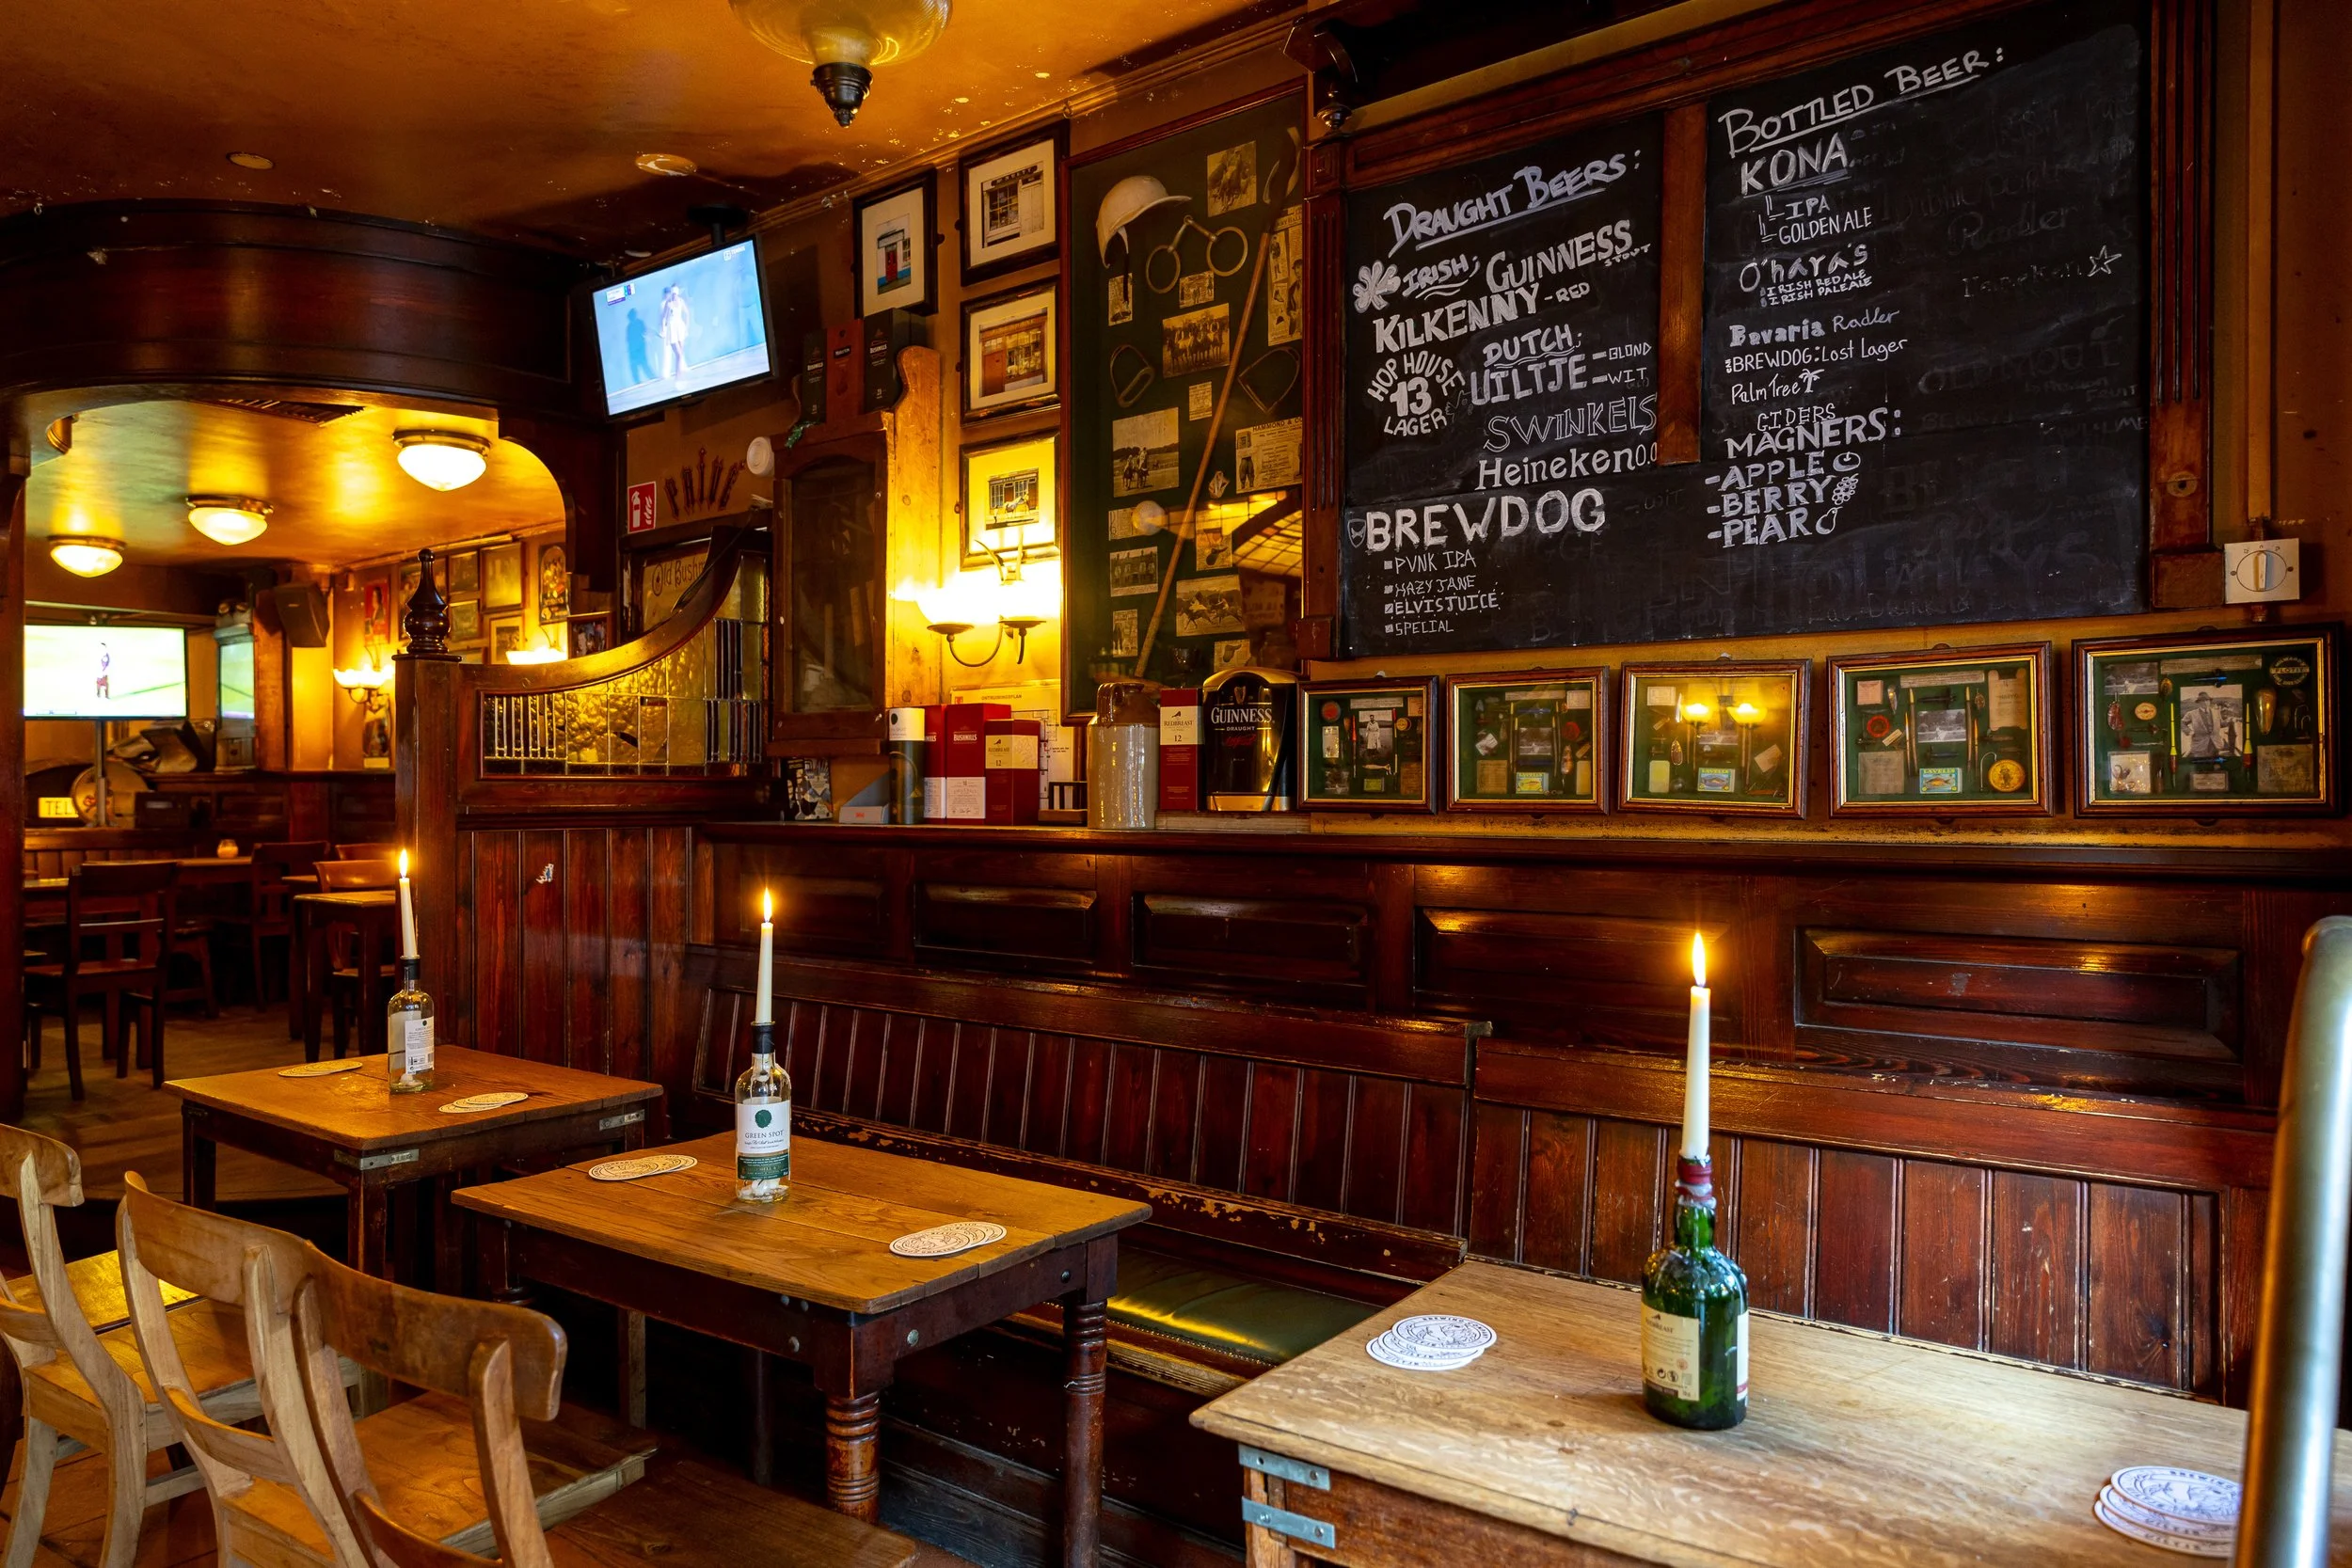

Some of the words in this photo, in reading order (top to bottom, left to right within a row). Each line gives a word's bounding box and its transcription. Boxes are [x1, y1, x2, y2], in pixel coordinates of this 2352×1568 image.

[1718, 85, 1874, 159] BOTTLED
[1740, 133, 1849, 197] KONA
[1383, 184, 1513, 258] DRAUGHT
[1778, 214, 1840, 245] GOLDEN
[1843, 206, 1872, 231] ALE
[1785, 194, 1831, 220] IPA
[1486, 219, 1633, 293] GUINNESS
[1603, 243, 1651, 267] STOUT
[1767, 279, 1812, 297] IRISH
[1816, 275, 1841, 288] RED
[1842, 269, 1867, 281] ALE
[1768, 290, 1813, 306] IRISH
[1818, 283, 1848, 296] PALE
[1848, 276, 1872, 291] ALE
[1373, 283, 1539, 354] KILKENNY
[1729, 318, 1826, 348] Bavaria
[1833, 307, 1900, 332] Radler
[1822, 339, 1854, 362] Lost
[1861, 337, 1908, 362] Lager
[1367, 357, 1399, 402] HOP
[1403, 350, 1466, 396] HOUSE
[1470, 353, 1588, 405] UILTJE
[1731, 382, 1767, 405] Palm
[1769, 373, 1801, 399] Tree
[1390, 376, 1432, 417] 13
[1383, 407, 1448, 437] LAGER
[1483, 392, 1658, 452] SWINKELS
[1474, 448, 1636, 490] Heineken
[1365, 488, 1607, 552] BREWDOG
[651, 560, 672, 596] Old
[1395, 579, 1434, 597] HAZY
[1436, 575, 1477, 594] JANE
[1395, 597, 1444, 615] ELVIS
[1444, 592, 1499, 612] JUICE
[1395, 620, 1454, 636] SPECIAL
[1211, 706, 1273, 724] GUINNESS
